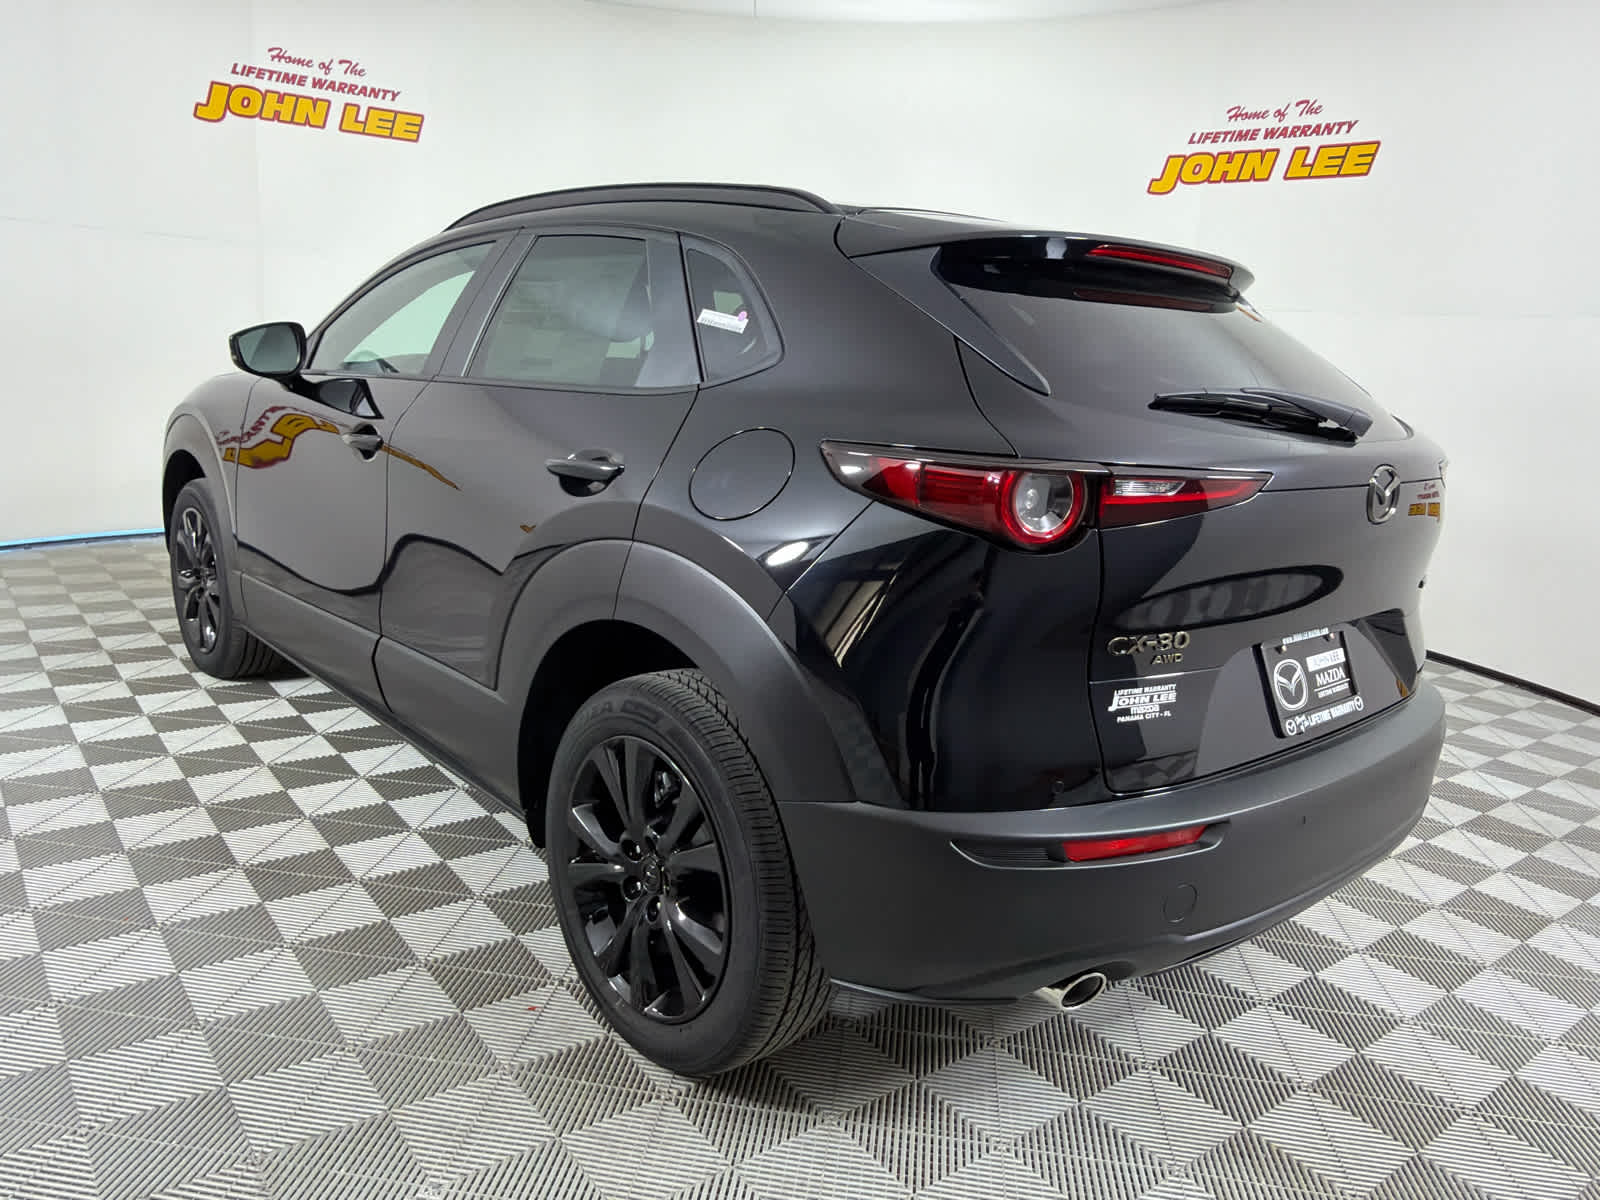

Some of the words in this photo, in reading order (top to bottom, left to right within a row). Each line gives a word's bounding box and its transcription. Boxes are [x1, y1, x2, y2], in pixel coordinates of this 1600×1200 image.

[268, 47, 314, 68] Home
[319, 59, 333, 75] of
[338, 59, 366, 77] The
[231, 63, 307, 87] LIFETIME
[312, 76, 401, 102] WARRANTY
[193, 81, 331, 129] JOHN
[338, 102, 424, 143] LEE
[1226, 105, 1269, 123] Home
[1273, 103, 1289, 121] of
[1295, 99, 1323, 117] The
[1188, 128, 1260, 145] LIFETIME
[1263, 120, 1359, 140] WARRANTY
[1147, 148, 1281, 195] JOHN
[1283, 141, 1381, 180] LEE
[1107, 631, 1190, 656] CX-30
[1152, 653, 1184, 665] AWD
[1315, 666, 1346, 686] MAZDA
[1108, 690, 1150, 711] JOHN
[1153, 693, 1177, 701] LEE
[1144, 684, 1176, 693] WARRANTY
[1117, 714, 1144, 722] PANAMA
